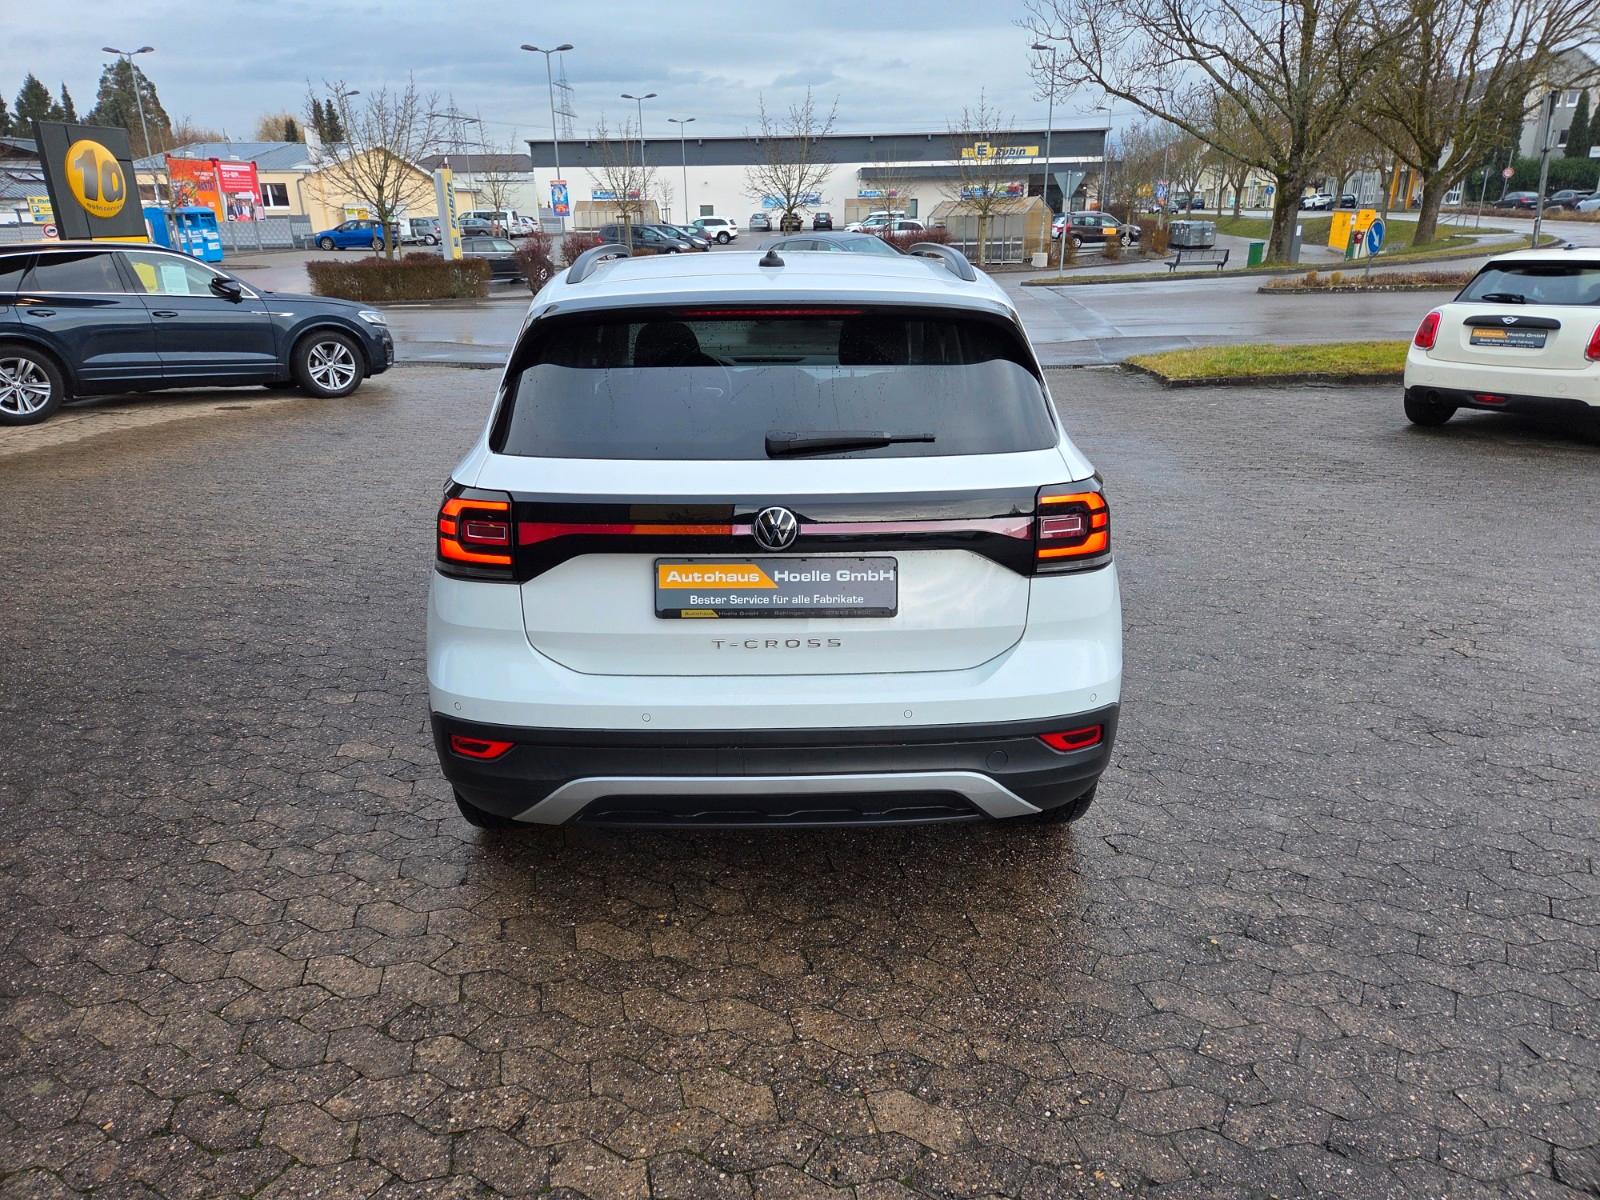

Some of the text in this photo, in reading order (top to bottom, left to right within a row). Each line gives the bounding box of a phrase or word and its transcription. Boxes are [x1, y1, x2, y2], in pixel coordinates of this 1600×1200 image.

[666, 569, 895, 582] Autohaus Hoelle GmbH
[690, 594, 864, 605] Bester Service für alle Fabrikate
[711, 638, 842, 650] T-CROSS
